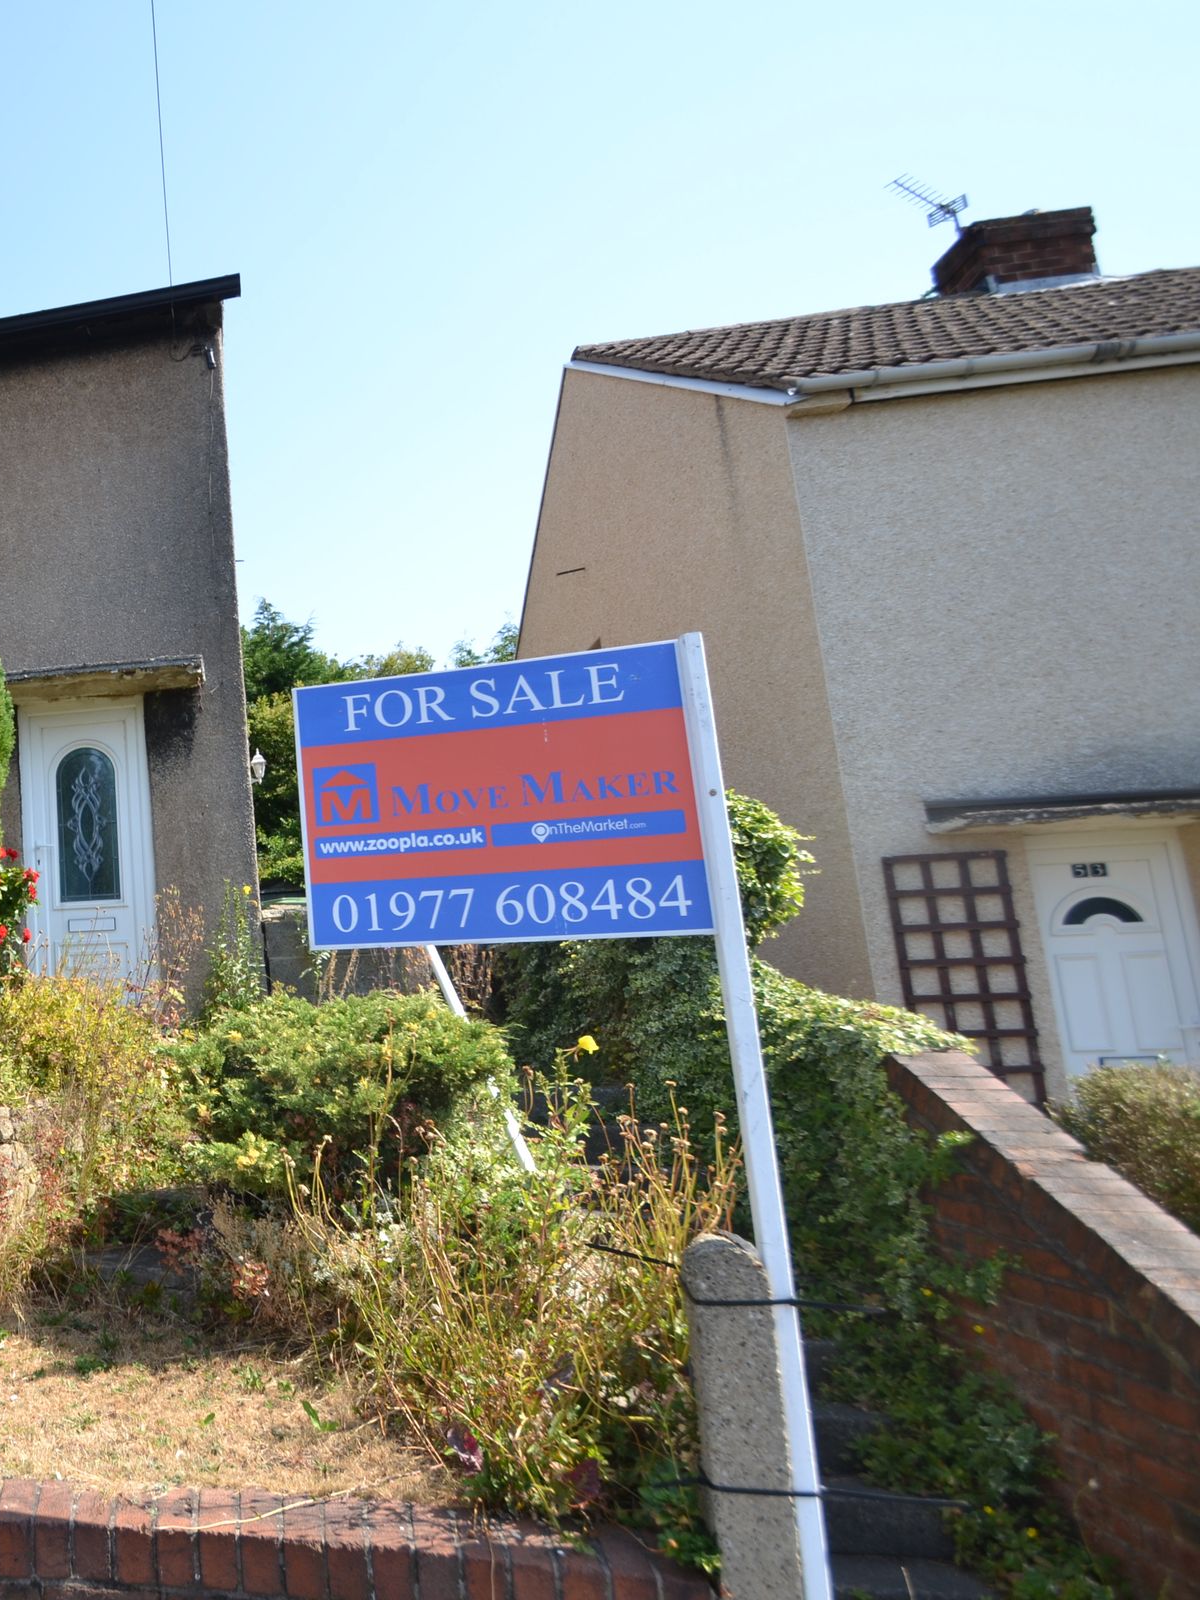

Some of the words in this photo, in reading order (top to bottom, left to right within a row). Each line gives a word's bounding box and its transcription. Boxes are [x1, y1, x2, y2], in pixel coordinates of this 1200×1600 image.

[341, 686, 455, 732] FOR
[471, 663, 625, 719] SALE
[320, 828, 484, 853] www.zoopla.co.uk
[331, 888, 475, 933] 01977
[495, 874, 693, 926] 608484
